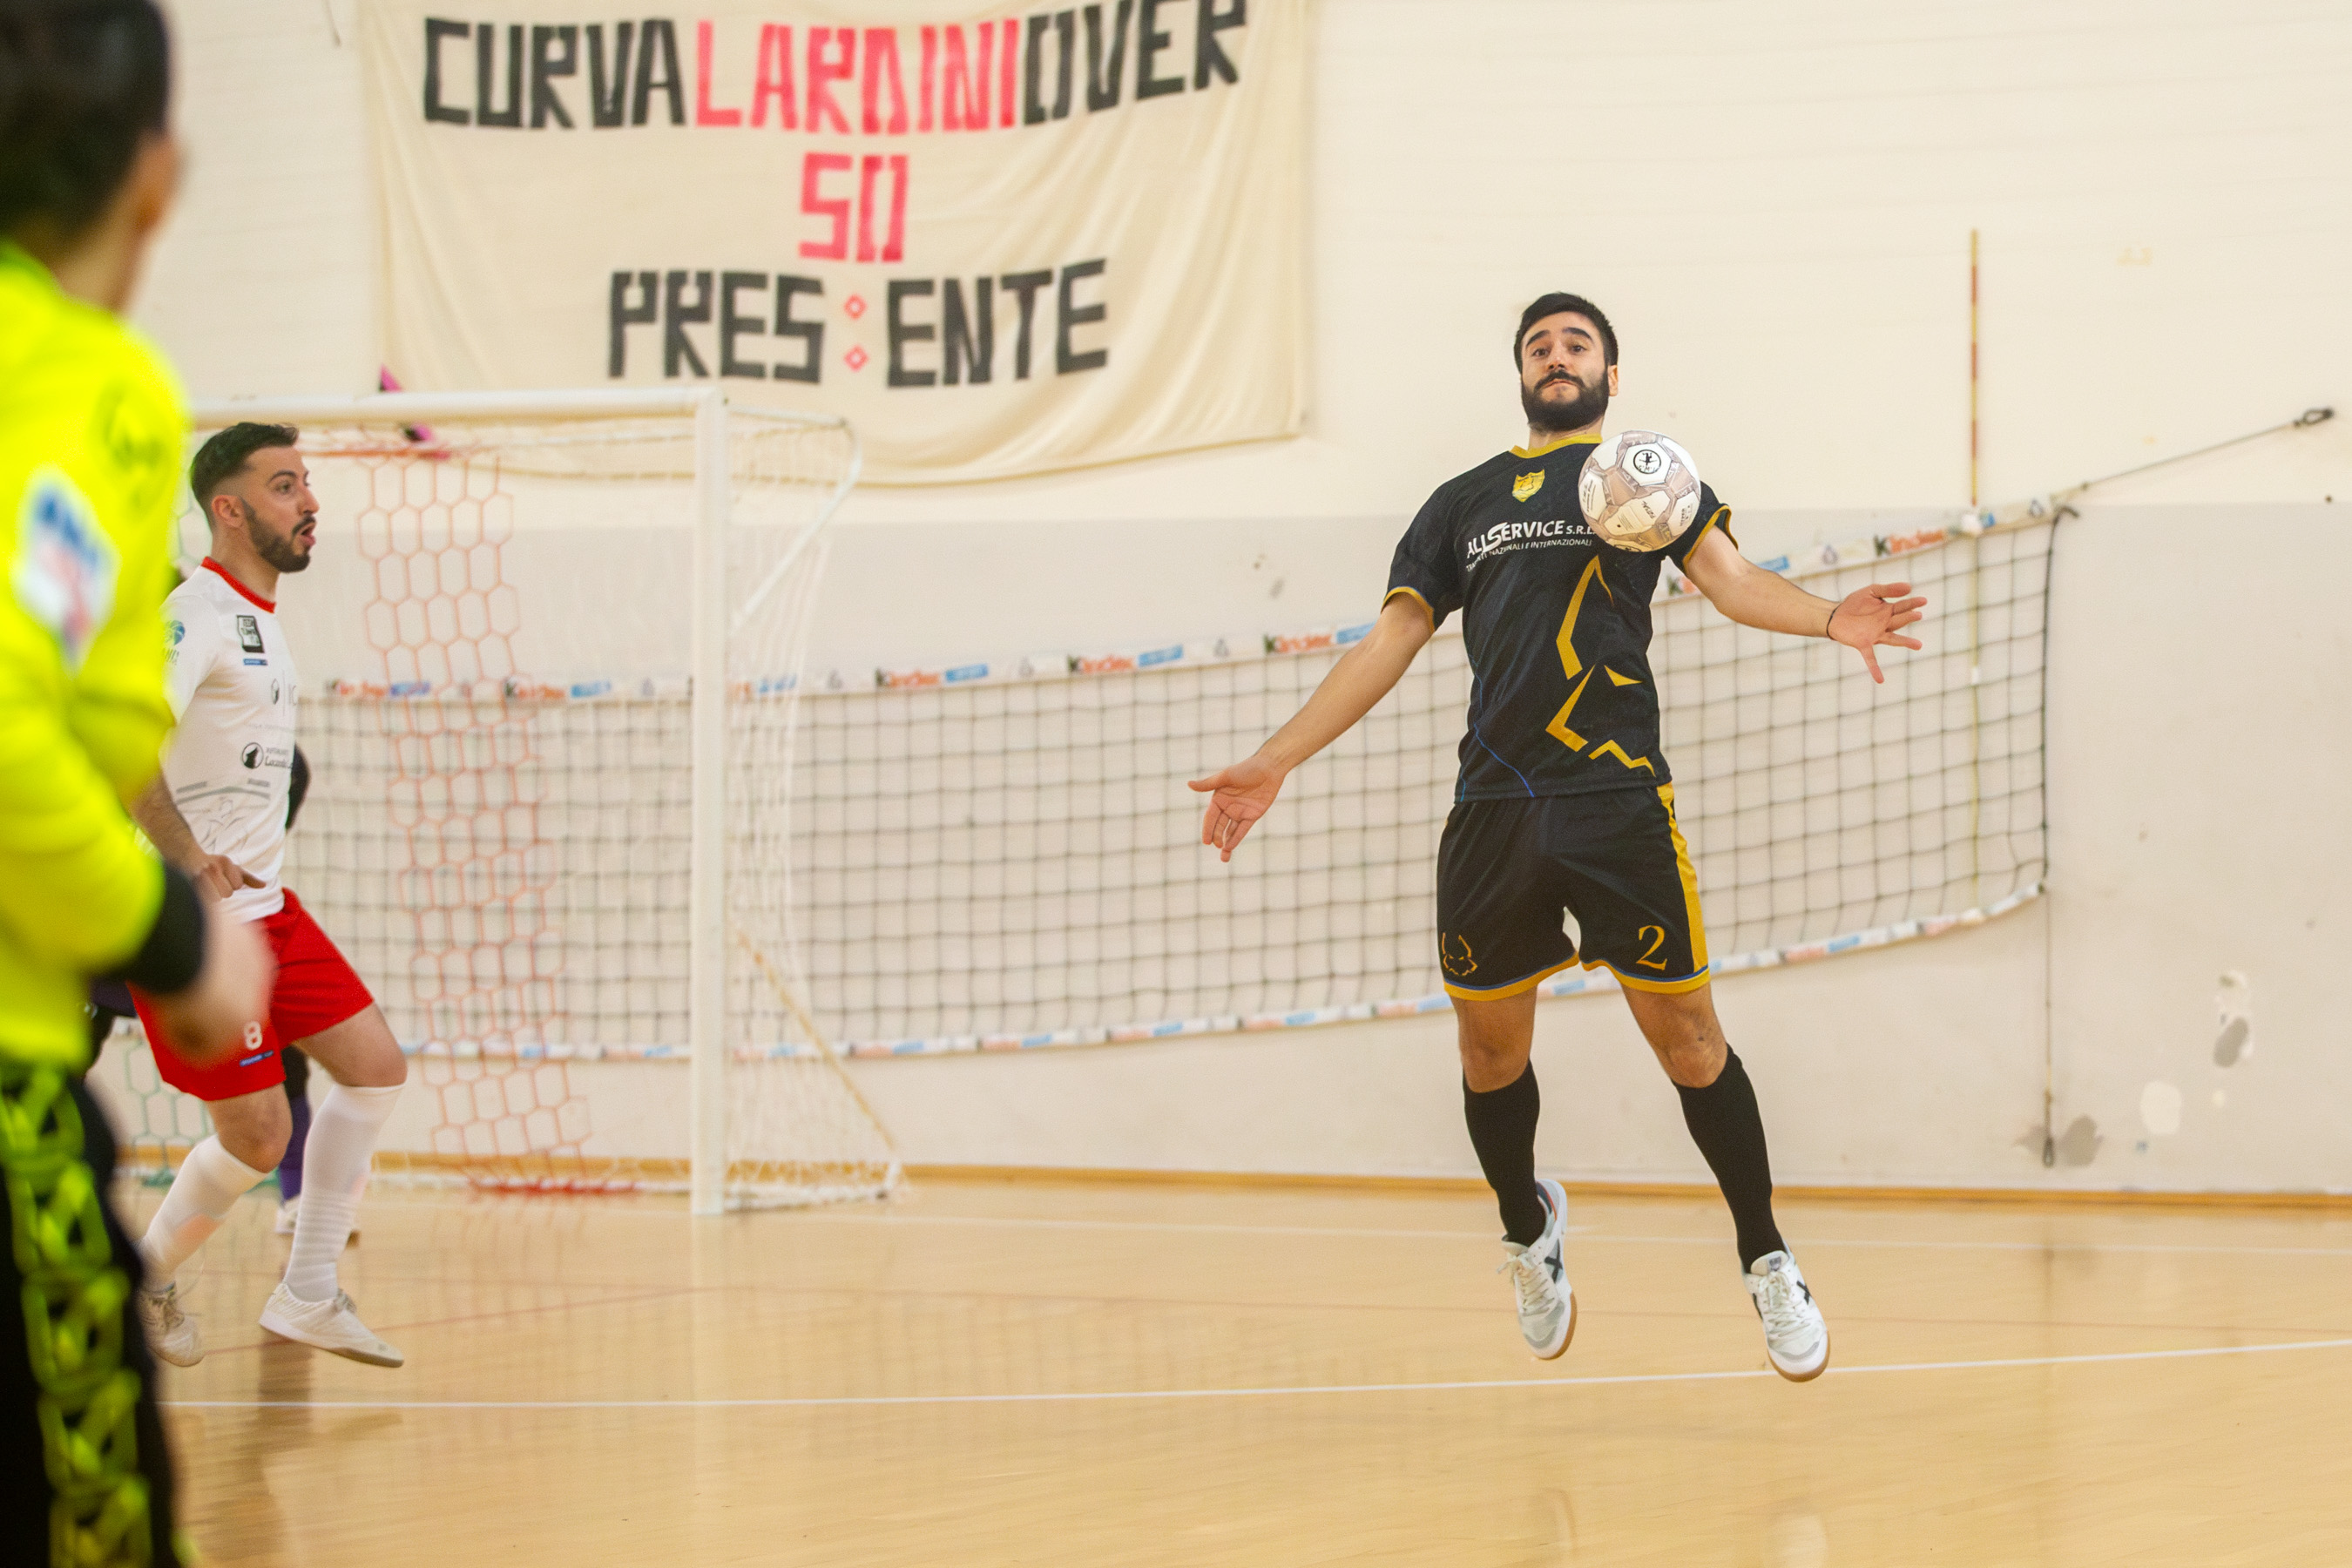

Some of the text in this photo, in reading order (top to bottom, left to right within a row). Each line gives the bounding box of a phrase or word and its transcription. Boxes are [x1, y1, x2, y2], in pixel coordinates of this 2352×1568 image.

[423, 0, 1247, 135] CURVA LARDINI OVER
[1636, 925, 1668, 970] 2
[244, 1020, 263, 1051] 8
